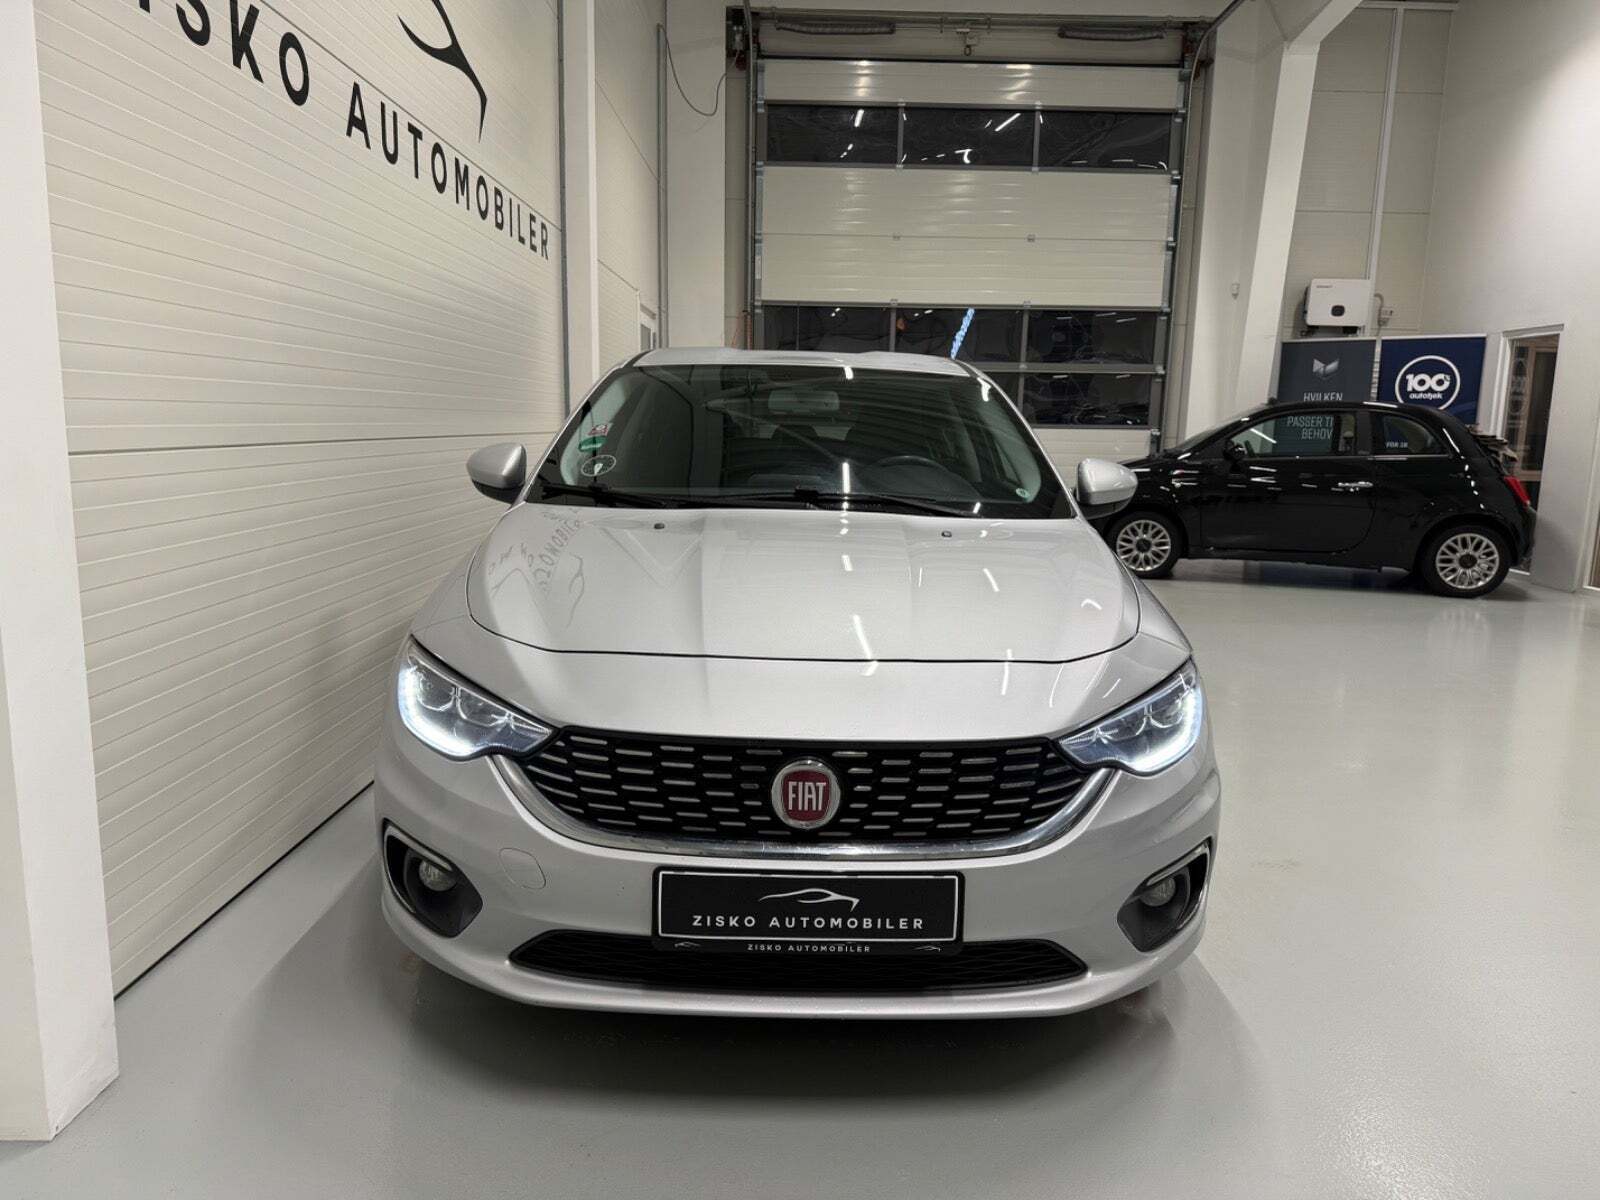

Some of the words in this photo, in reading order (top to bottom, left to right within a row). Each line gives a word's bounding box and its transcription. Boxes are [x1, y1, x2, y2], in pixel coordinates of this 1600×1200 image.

[346, 82, 549, 260] AUTOMOBILER
[1303, 392, 1343, 402] HVILKEN
[1287, 416, 1323, 427] PASSER
[788, 781, 827, 811] FIAT
[692, 915, 756, 928] ZISKO
[769, 917, 924, 930] AUTOMOBILER
[747, 943, 782, 952] ZISKO
[787, 943, 871, 953] AUTOMOBILER
